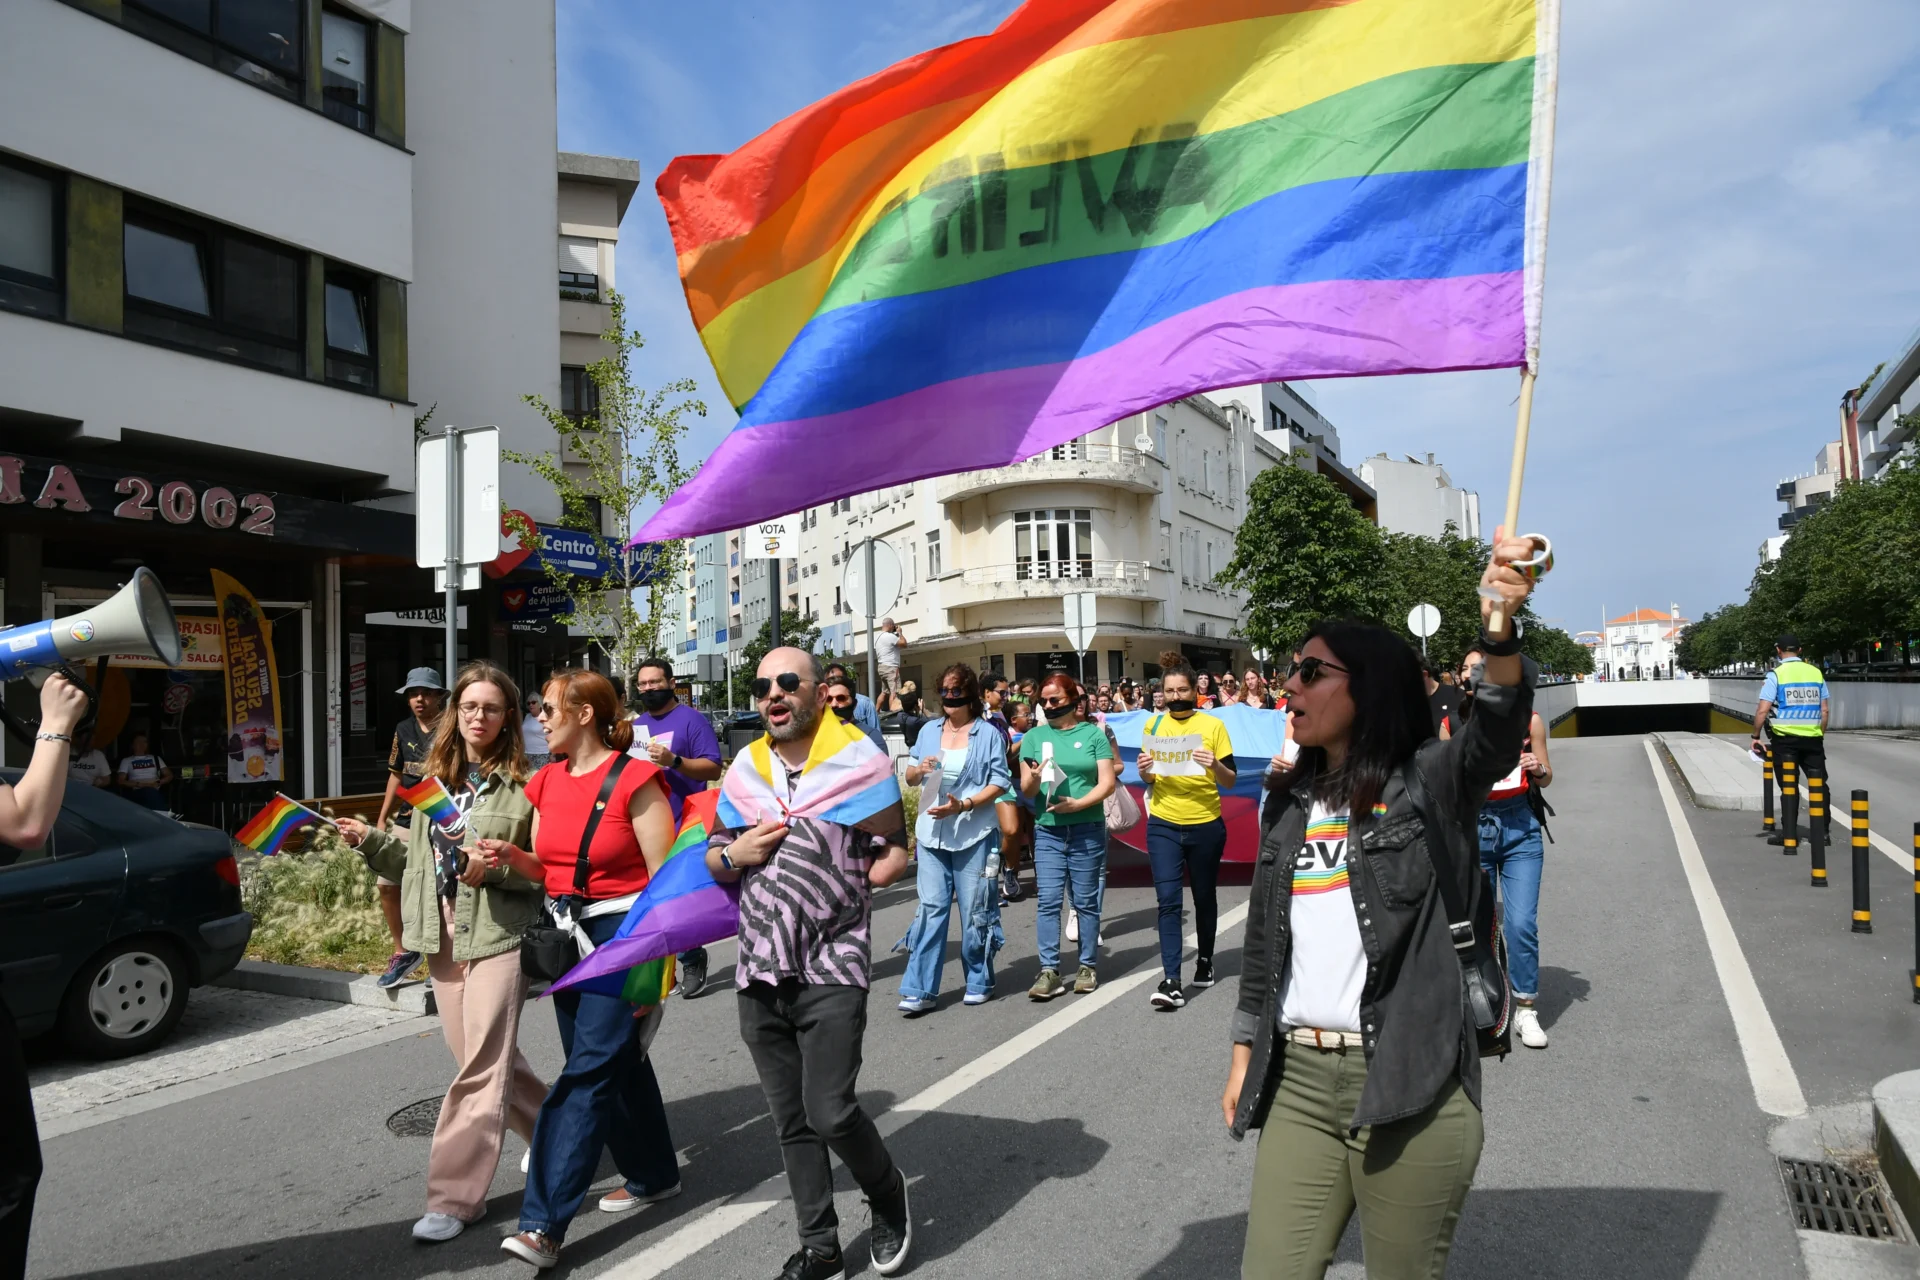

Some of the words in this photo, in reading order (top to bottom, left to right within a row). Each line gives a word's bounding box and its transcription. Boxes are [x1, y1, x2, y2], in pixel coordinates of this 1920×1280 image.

[113, 476, 276, 536] 2002
[758, 524, 786, 535] VOTA
[542, 533, 596, 556] Centro
[619, 544, 661, 567] juda
[532, 586, 561, 595] Centro
[528, 597, 539, 606] de
[540, 595, 567, 607] Ajuda
[187, 653, 224, 664] SALGA
[1787, 688, 1819, 699] POLÍCIA
[1149, 748, 1193, 764] RESPEIT
[72, 762, 97, 770] adidas
[1294, 840, 1348, 871] ev
